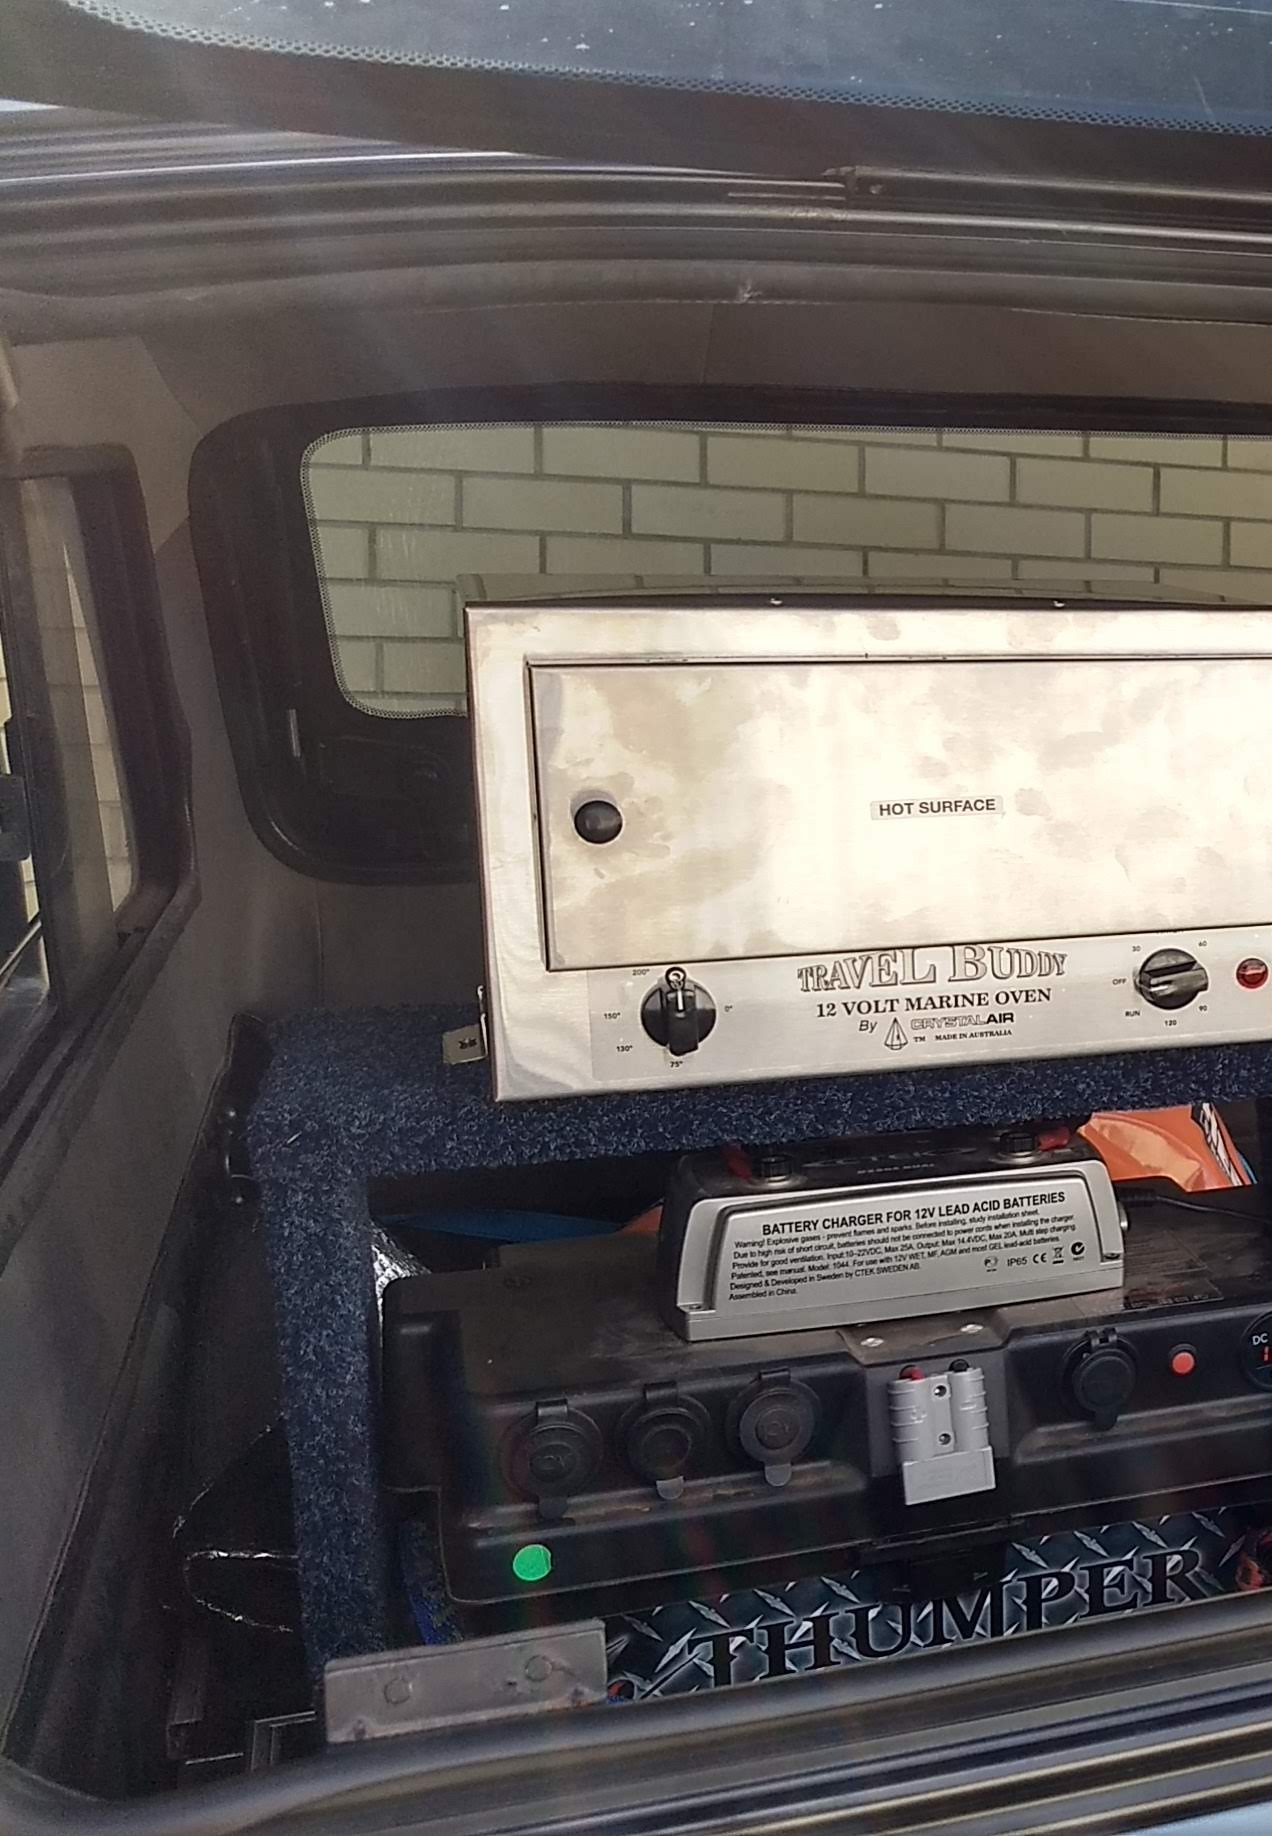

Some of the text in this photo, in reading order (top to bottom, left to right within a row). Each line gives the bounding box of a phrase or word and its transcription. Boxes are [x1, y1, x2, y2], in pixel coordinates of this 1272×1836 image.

[879, 799, 996, 816] HOT SURFACE
[1198, 940, 1207, 948] 60
[797, 944, 1068, 992] TRAVEL BUDDY
[816, 988, 1052, 1018] 12 VOLT MARINE OVEN
[858, 1020, 877, 1034] By
[935, 1033, 957, 1041] MADE
[969, 1029, 1013, 1039] AUSTRALIA
[762, 1191, 1065, 1236] BATTERY CHARGER FOR 12V LEAD ACID BATTERIES
[733, 1250, 748, 1259] Due
[750, 1249, 756, 1257] to
[758, 1248, 771, 1257] high
[774, 1246, 785, 1254] risk
[787, 1245, 794, 1253] of
[796, 1243, 812, 1252] short
[836, 1237, 864, 1247] batteries
[866, 1235, 888, 1244] should
[890, 1233, 900, 1241] not
[902, 1232, 910, 1240] be
[912, 1229, 944, 1238] connected
[954, 1227, 972, 1235] power
[975, 1223, 992, 1231] cords
[994, 1221, 1010, 1229] when
[1012, 1218, 1038, 1227] installing
[734, 1239, 764, 1249] Warning!
[766, 1235, 798, 1245] Explosive
[801, 1234, 818, 1242] gases
[826, 1229, 851, 1239] prevent
[853, 1227, 874, 1235] flames
[876, 1225, 888, 1233] and
[915, 1220, 936, 1228] Before
[968, 1214, 985, 1222] study
[987, 1211, 1019, 1220] installation
[732, 1260, 758, 1269] Provide
[760, 1258, 768, 1266] for
[770, 1256, 787, 1266] good
[884, 1244, 898, 1252] Max
[941, 1237, 955, 1245] Max
[988, 1232, 1001, 1240] Max
[852, 1257, 863, 1266] For
[879, 1254, 892, 1263] with
[894, 1253, 907, 1261] 12V
[958, 1245, 970, 1253] and
[971, 1243, 987, 1252] most
[988, 1242, 1002, 1250] GEL
[1003, 1239, 1032, 1248] lead-acid
[1007, 1256, 1028, 1266] IP65
[729, 1280, 762, 1290] Designed
[764, 1278, 769, 1286] &
[770, 1275, 807, 1285] Developed
[808, 1273, 815, 1281] in
[816, 1270, 844, 1280] Sweden
[845, 1269, 853, 1278] by
[854, 1267, 874, 1276] CTEK
[876, 1263, 908, 1273] SWEDEN
[728, 1290, 766, 1300] Assembled
[1252, 1332, 1269, 1346] DC
[694, 1547, 1207, 1688] THUMPER
